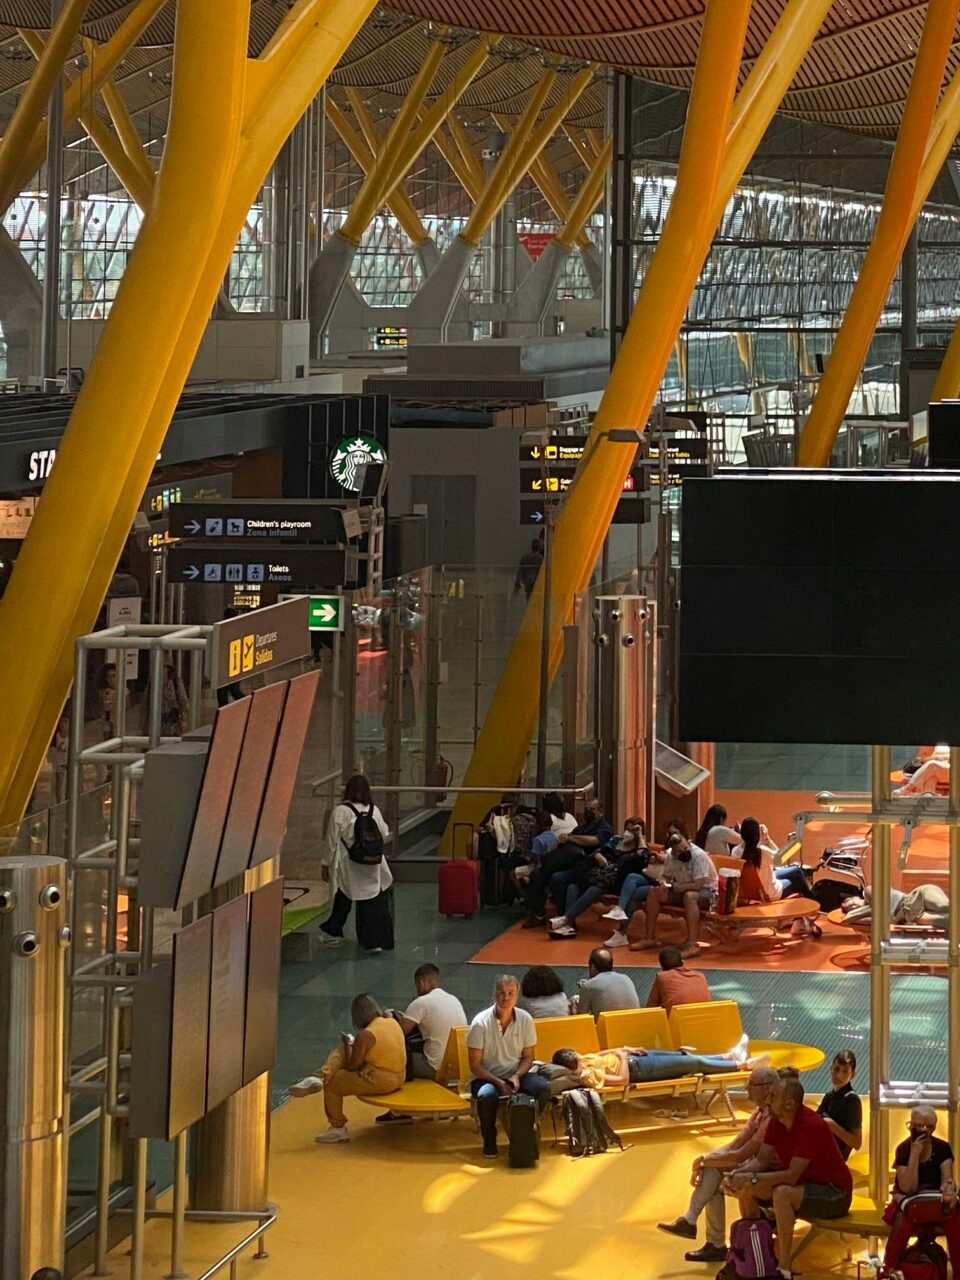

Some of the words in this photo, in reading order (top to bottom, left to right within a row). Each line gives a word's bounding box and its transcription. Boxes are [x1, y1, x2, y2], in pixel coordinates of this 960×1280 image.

[246, 520, 279, 528] Children's
[280, 520, 312, 529] playroom
[246, 529, 267, 537] Zona
[268, 564, 290, 572] Toilets
[268, 573, 292, 581] Aseos
[255, 631, 278, 648] Departures
[255, 648, 273, 666] Salidas
